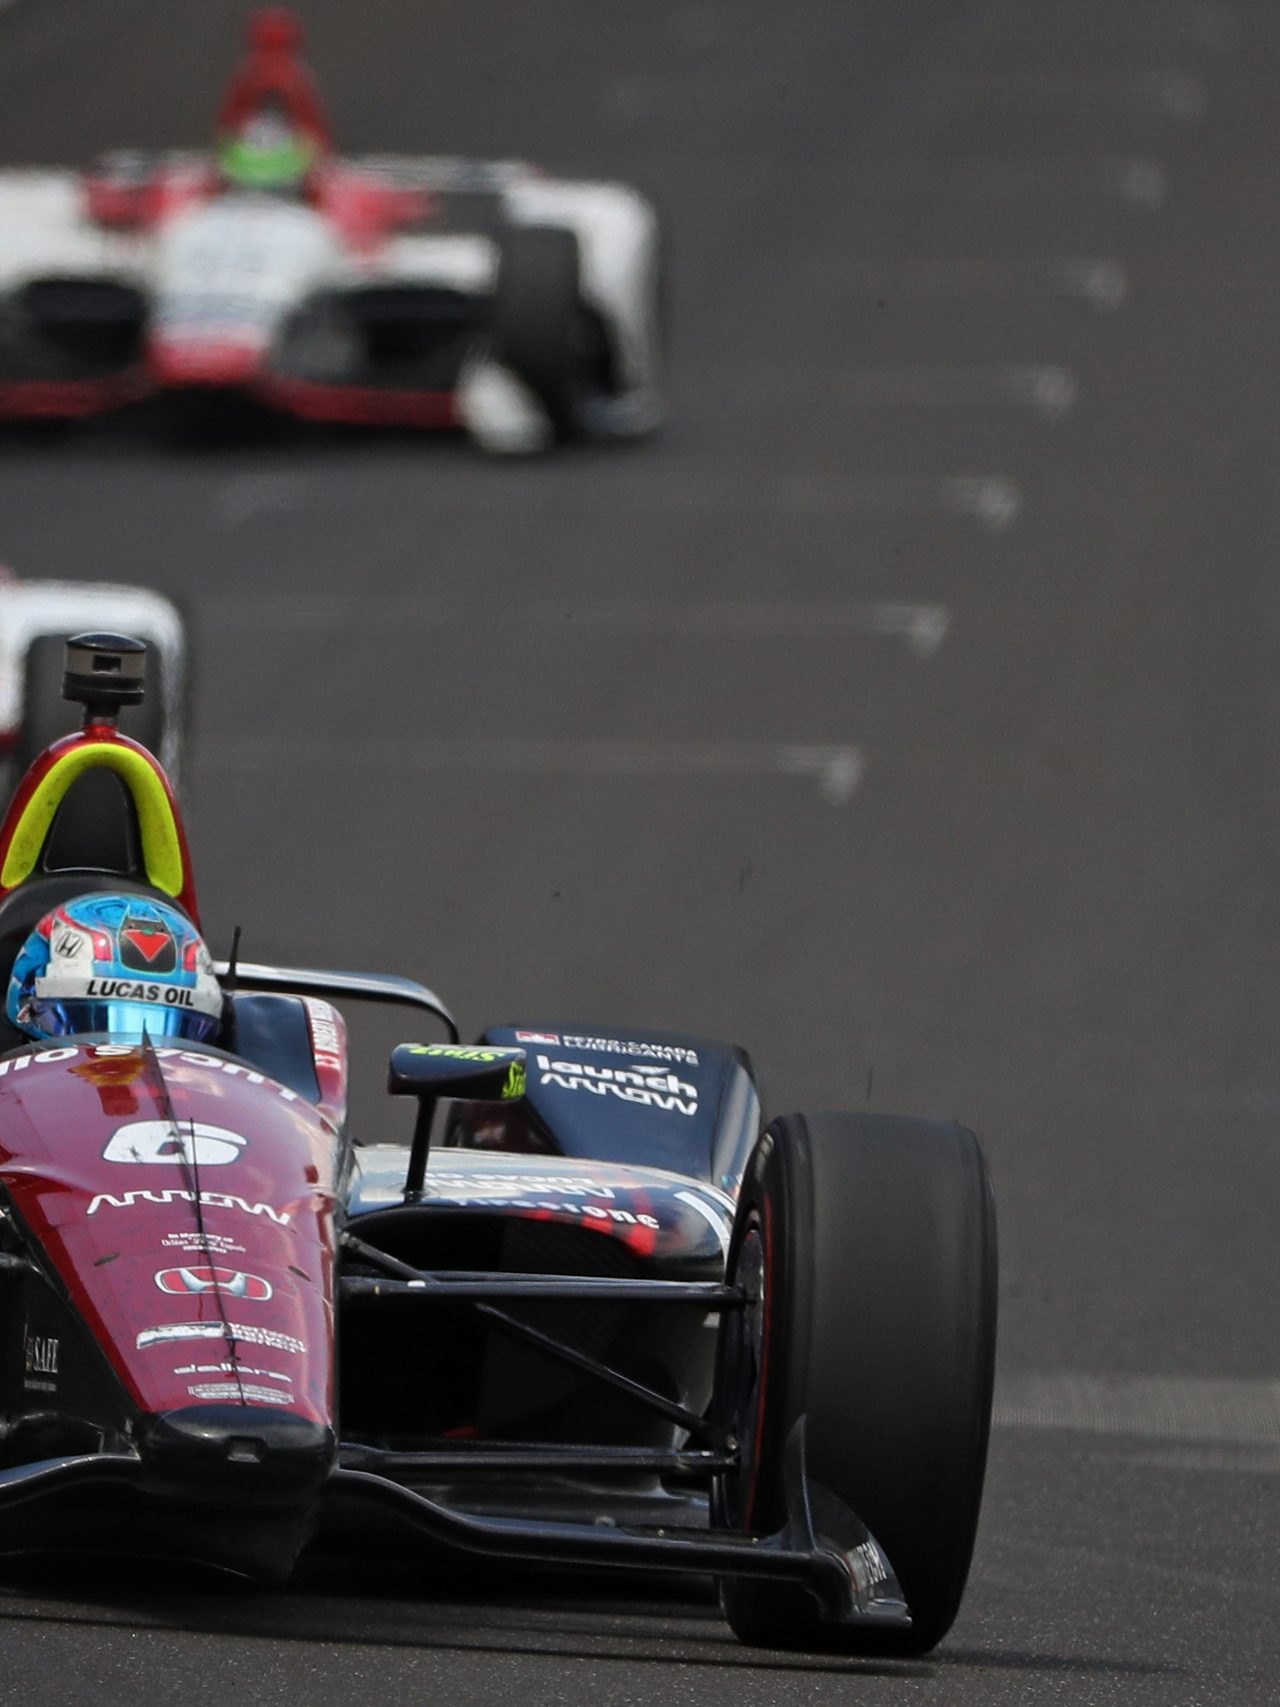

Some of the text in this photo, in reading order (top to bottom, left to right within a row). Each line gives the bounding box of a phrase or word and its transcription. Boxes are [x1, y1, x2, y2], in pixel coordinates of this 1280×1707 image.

[86, 979, 195, 1008] LUCAS OIL
[535, 1054, 698, 1098] launch
[540, 1072, 699, 1116] ARROW
[102, 1119, 248, 1165] 6
[86, 1189, 291, 1226] ARROW
